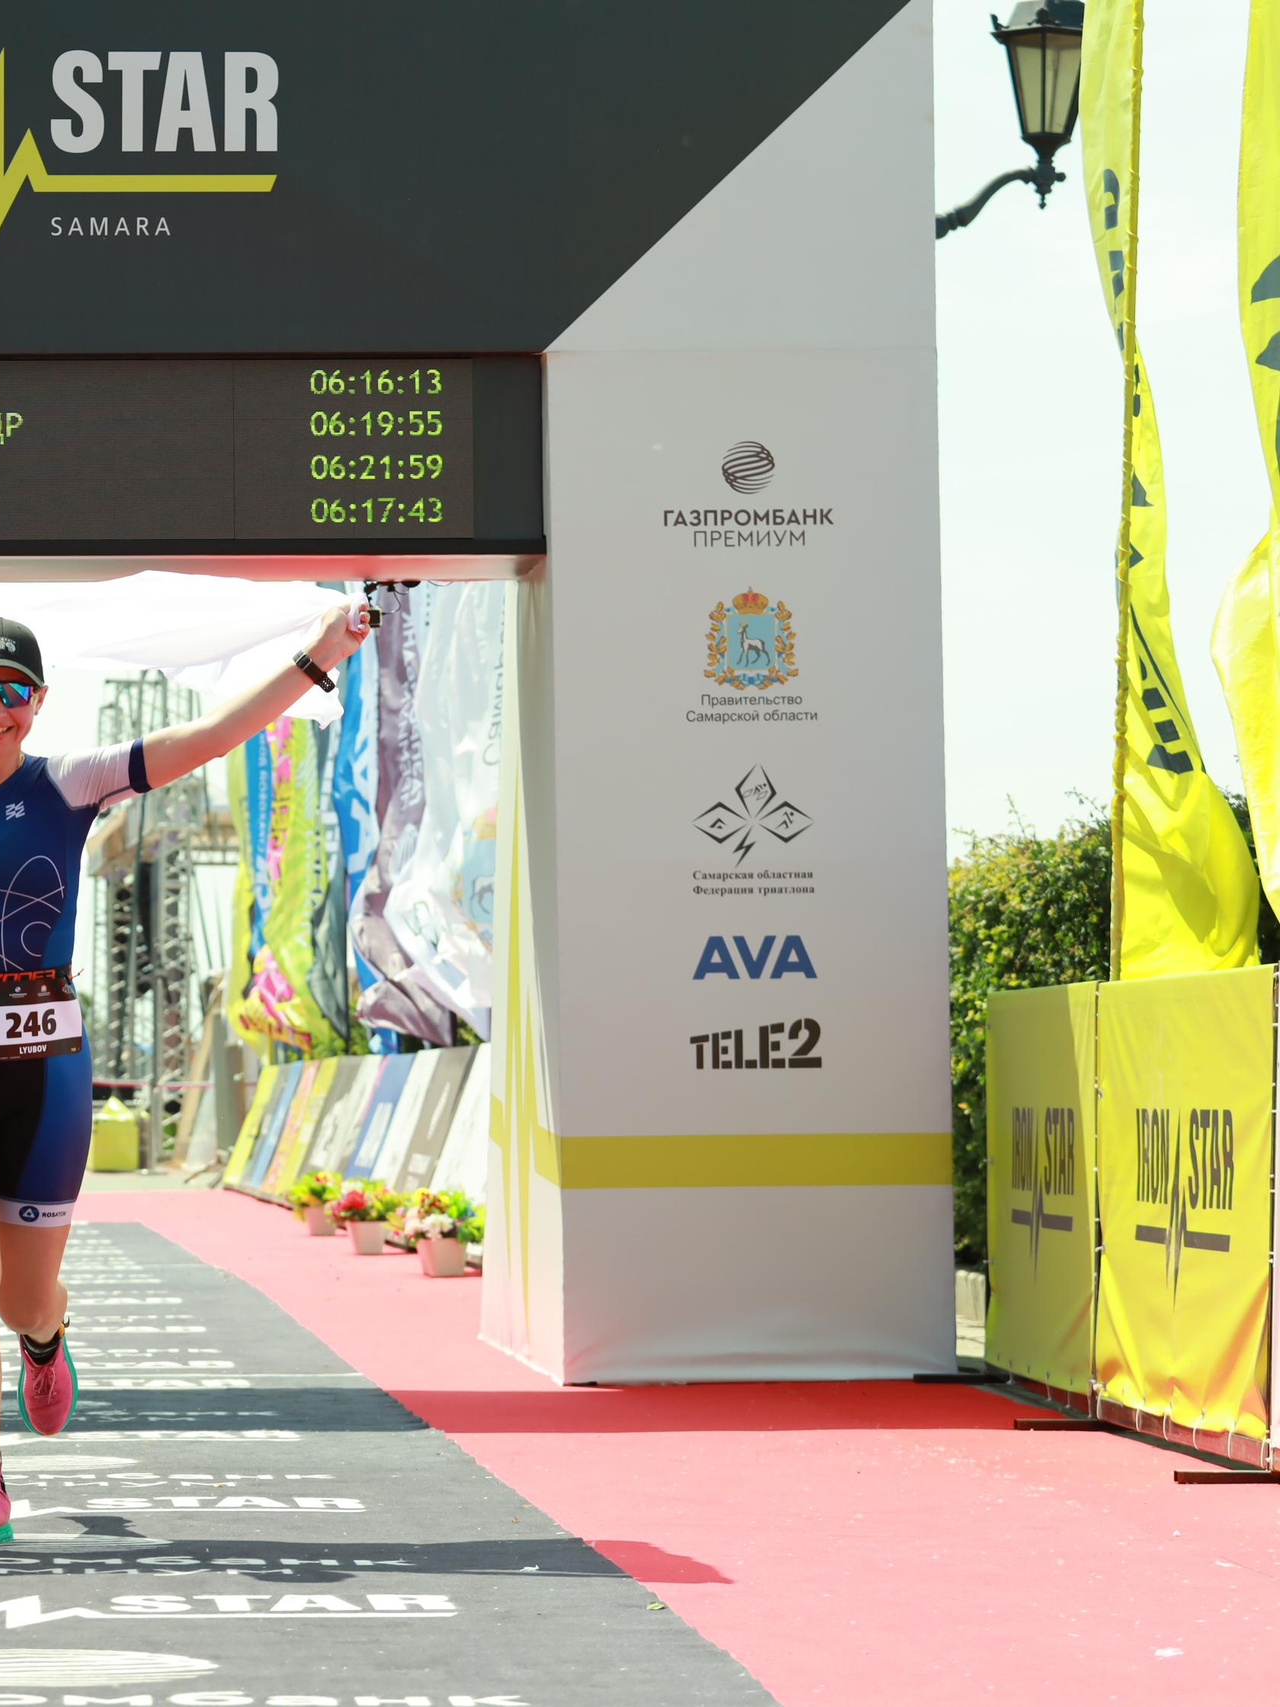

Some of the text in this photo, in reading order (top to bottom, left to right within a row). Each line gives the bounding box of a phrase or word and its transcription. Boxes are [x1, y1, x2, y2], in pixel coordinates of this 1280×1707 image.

[50, 50, 279, 153] STAR
[50, 216, 171, 236] SAMARA
[310, 369, 443, 395] 06:16:13
[310, 411, 443, 436] 06:19:55
[310, 454, 443, 480] 06:21:59
[310, 498, 443, 523] 06:17:43
[663, 508, 834, 527] ГАЗПРОМБАНК
[693, 530, 806, 548] ПРЕМИУМ
[700, 694, 803, 708] Правительство
[686, 709, 818, 724] Самарской области
[692, 869, 814, 882] Самарская областная
[692, 884, 815, 897] Федерация триатлона
[692, 935, 818, 980] AVA
[5, 1008, 57, 1039] 246
[19, 1044, 47, 1054] LYUBOV
[689, 1017, 822, 1070] TELE2
[1011, 1106, 1075, 1196] IRON STAR
[1136, 1107, 1234, 1211] IRON STAR
[68, 1430, 303, 1440] STAR
[86, 1496, 366, 1509] STAR
[109, 1593, 458, 1613] STAR
